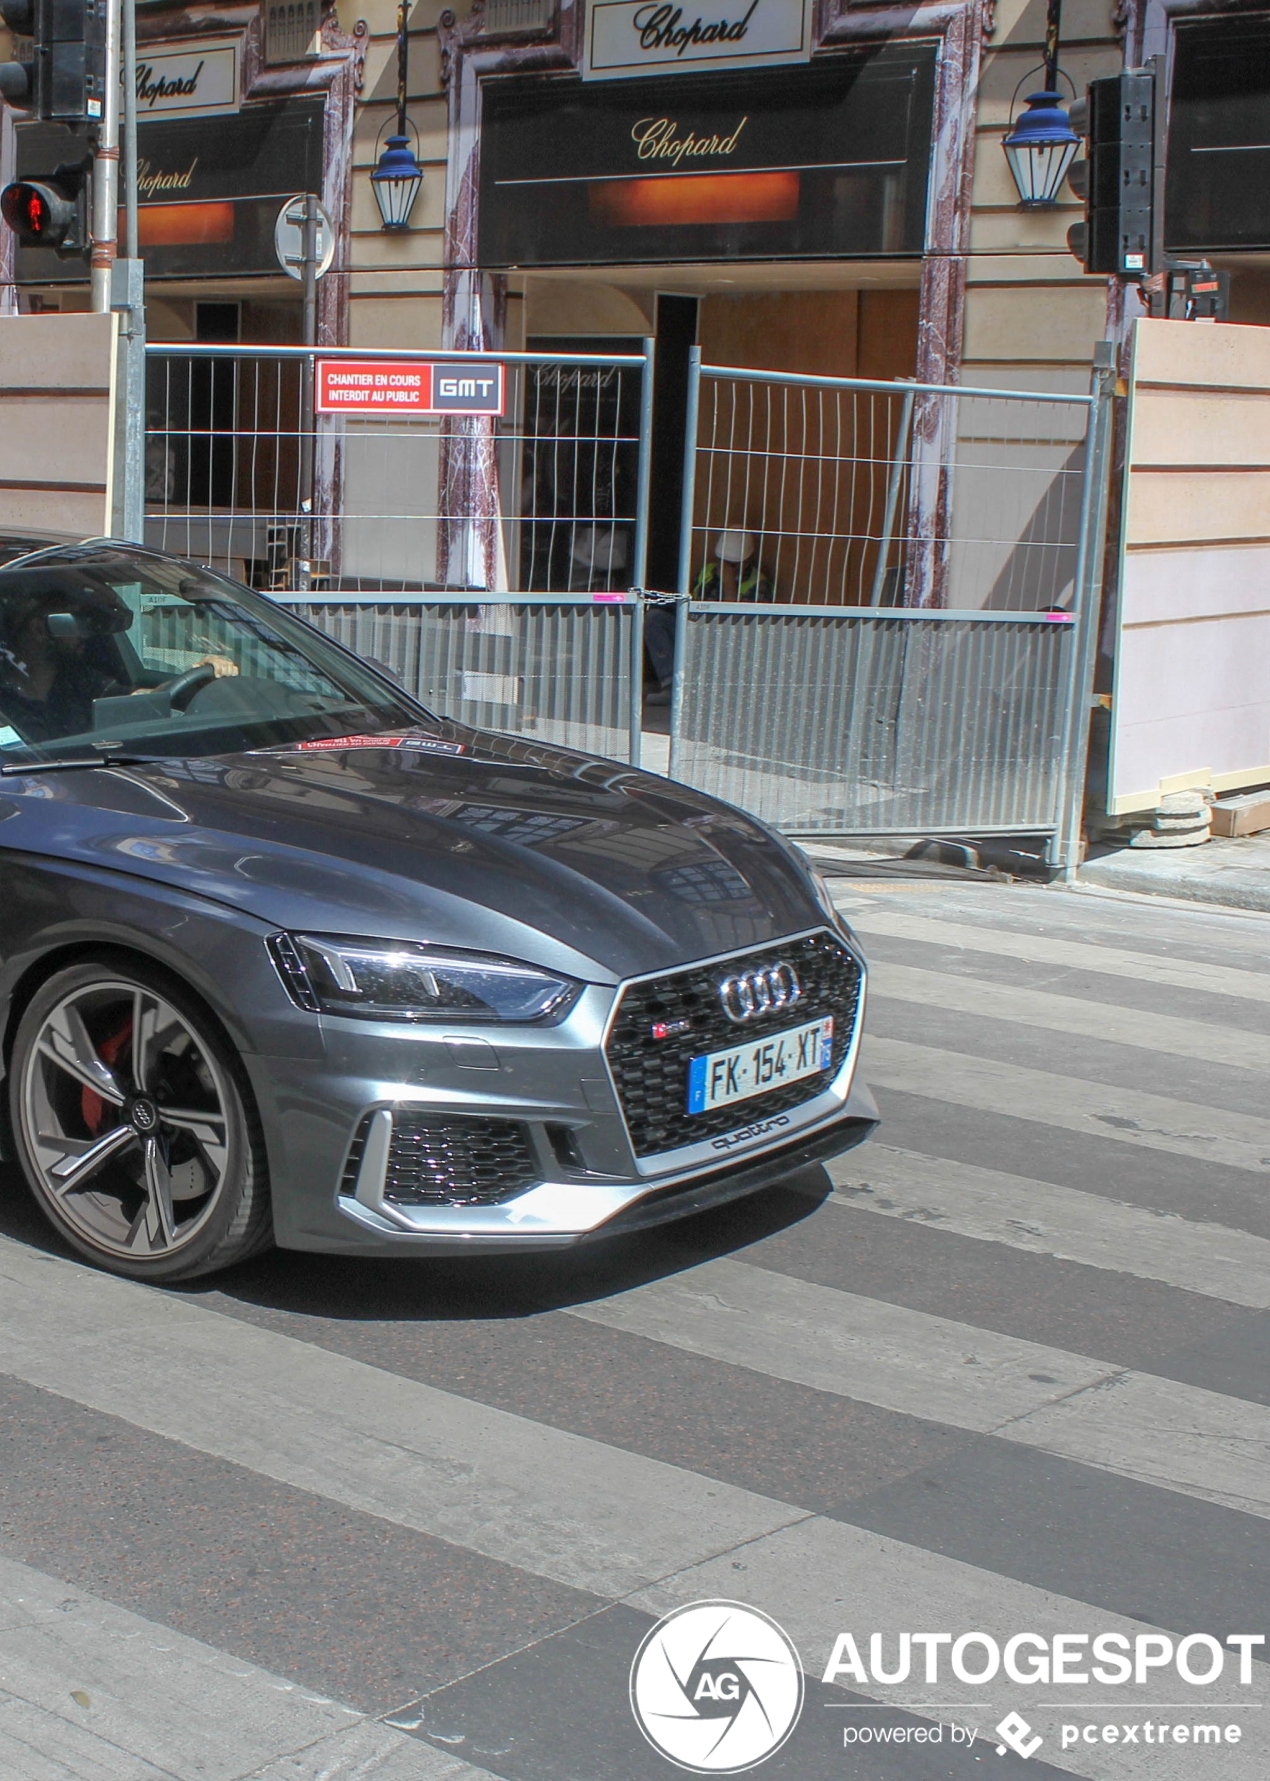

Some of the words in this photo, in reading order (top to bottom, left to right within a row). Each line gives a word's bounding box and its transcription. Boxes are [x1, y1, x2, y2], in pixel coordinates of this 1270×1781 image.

[633, 0, 759, 57] Chopard
[631, 116, 748, 167] Chopard
[327, 373, 373, 386] CHANTIER
[375, 374, 387, 386] EN
[389, 374, 421, 387] COURS
[328, 389, 370, 402] INTERDIT
[371, 390, 384, 402] AU
[386, 390, 420, 403] PUBLIC
[439, 378, 494, 398] GMT
[710, 1027, 821, 1101] FK-154-XT
[711, 1115, 790, 1150] quattro
